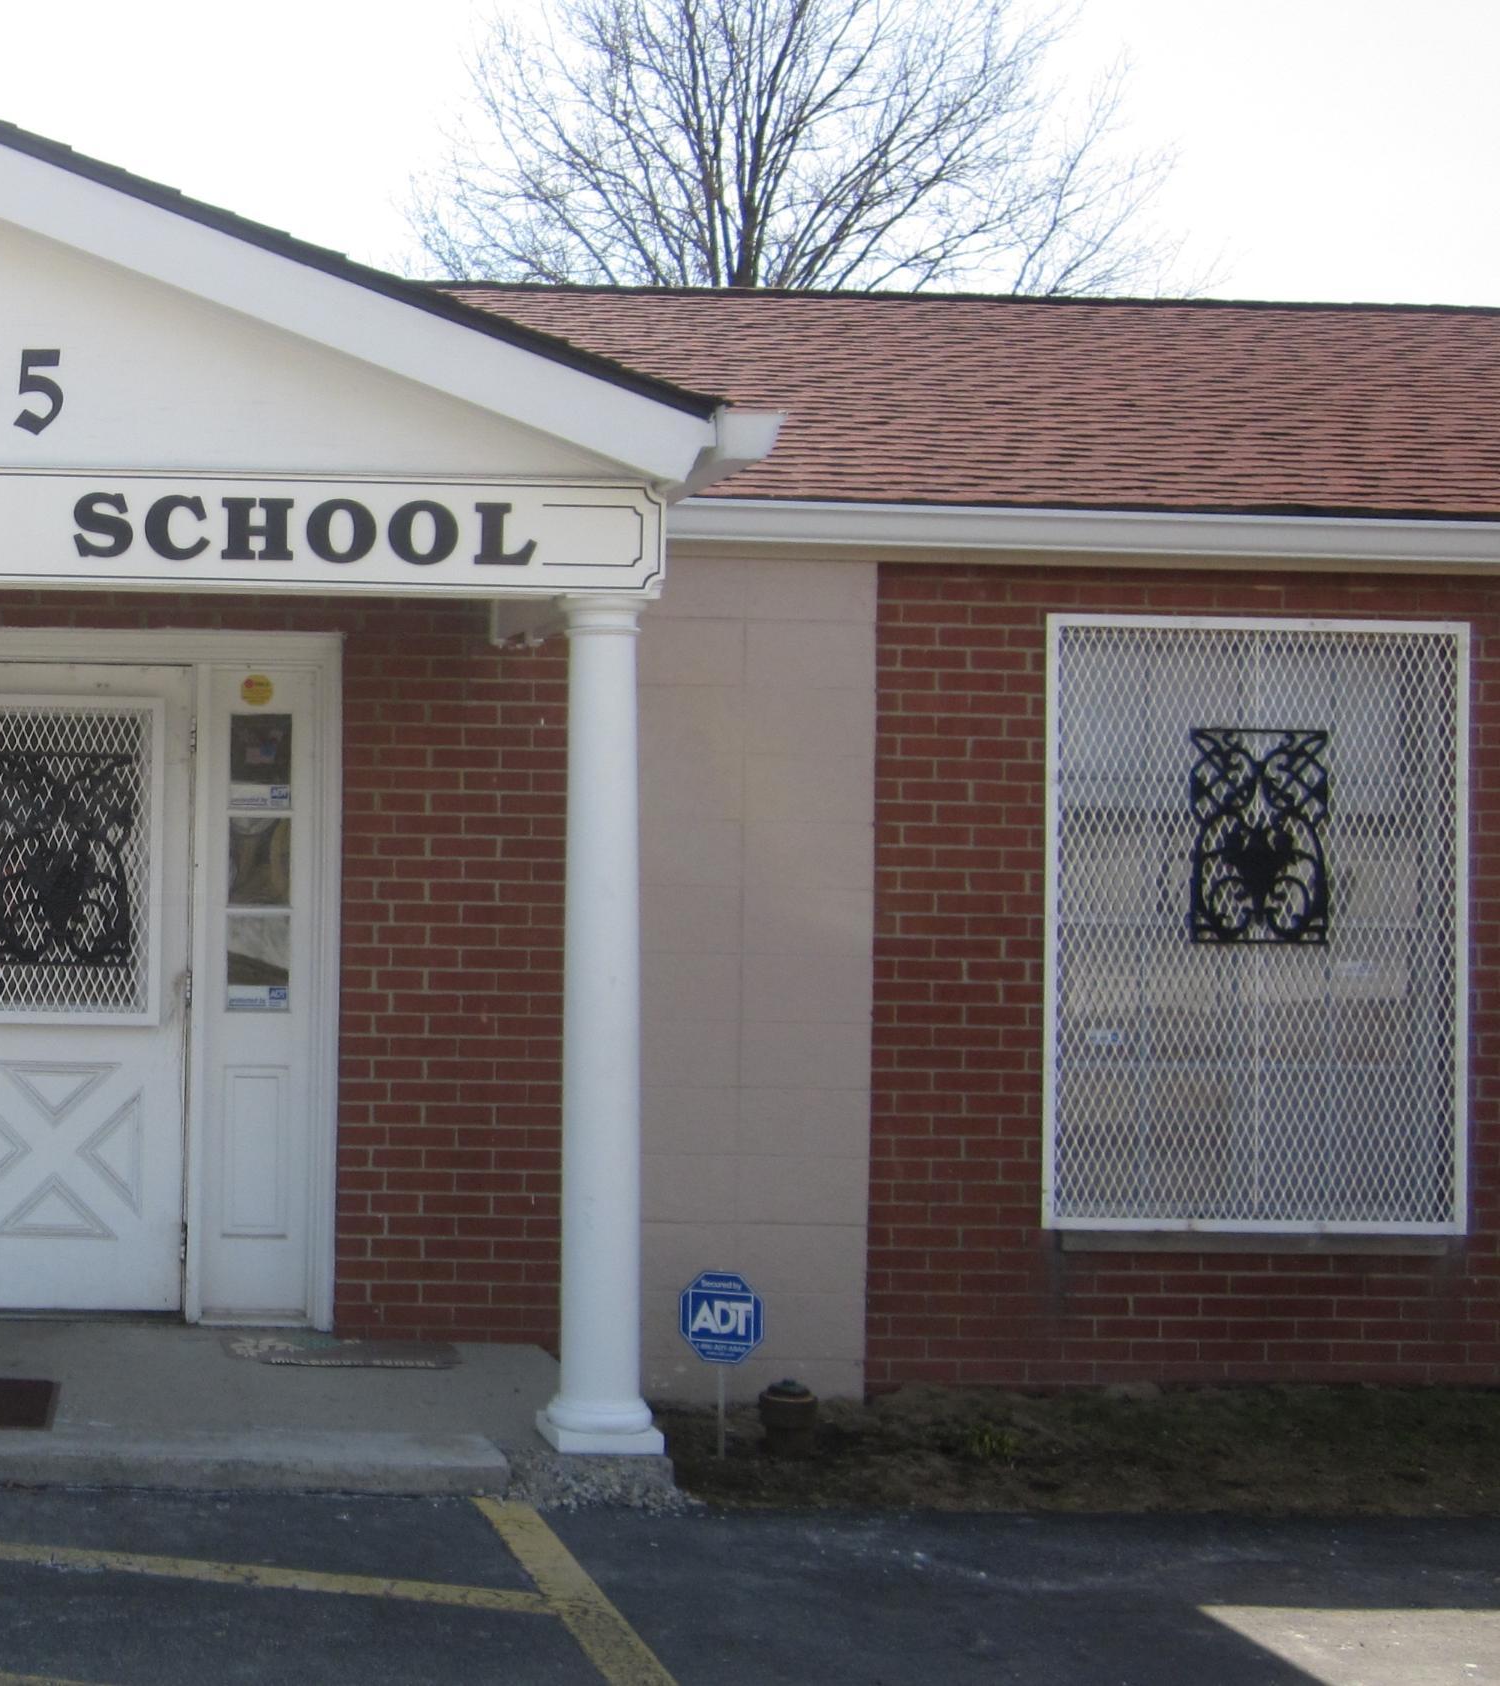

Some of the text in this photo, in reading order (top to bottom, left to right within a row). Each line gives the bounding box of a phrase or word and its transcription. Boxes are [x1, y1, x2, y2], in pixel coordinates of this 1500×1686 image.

[73, 492, 538, 567] SCHOOL
[701, 1279, 731, 1289] Secured
[691, 1300, 753, 1336] ADT
